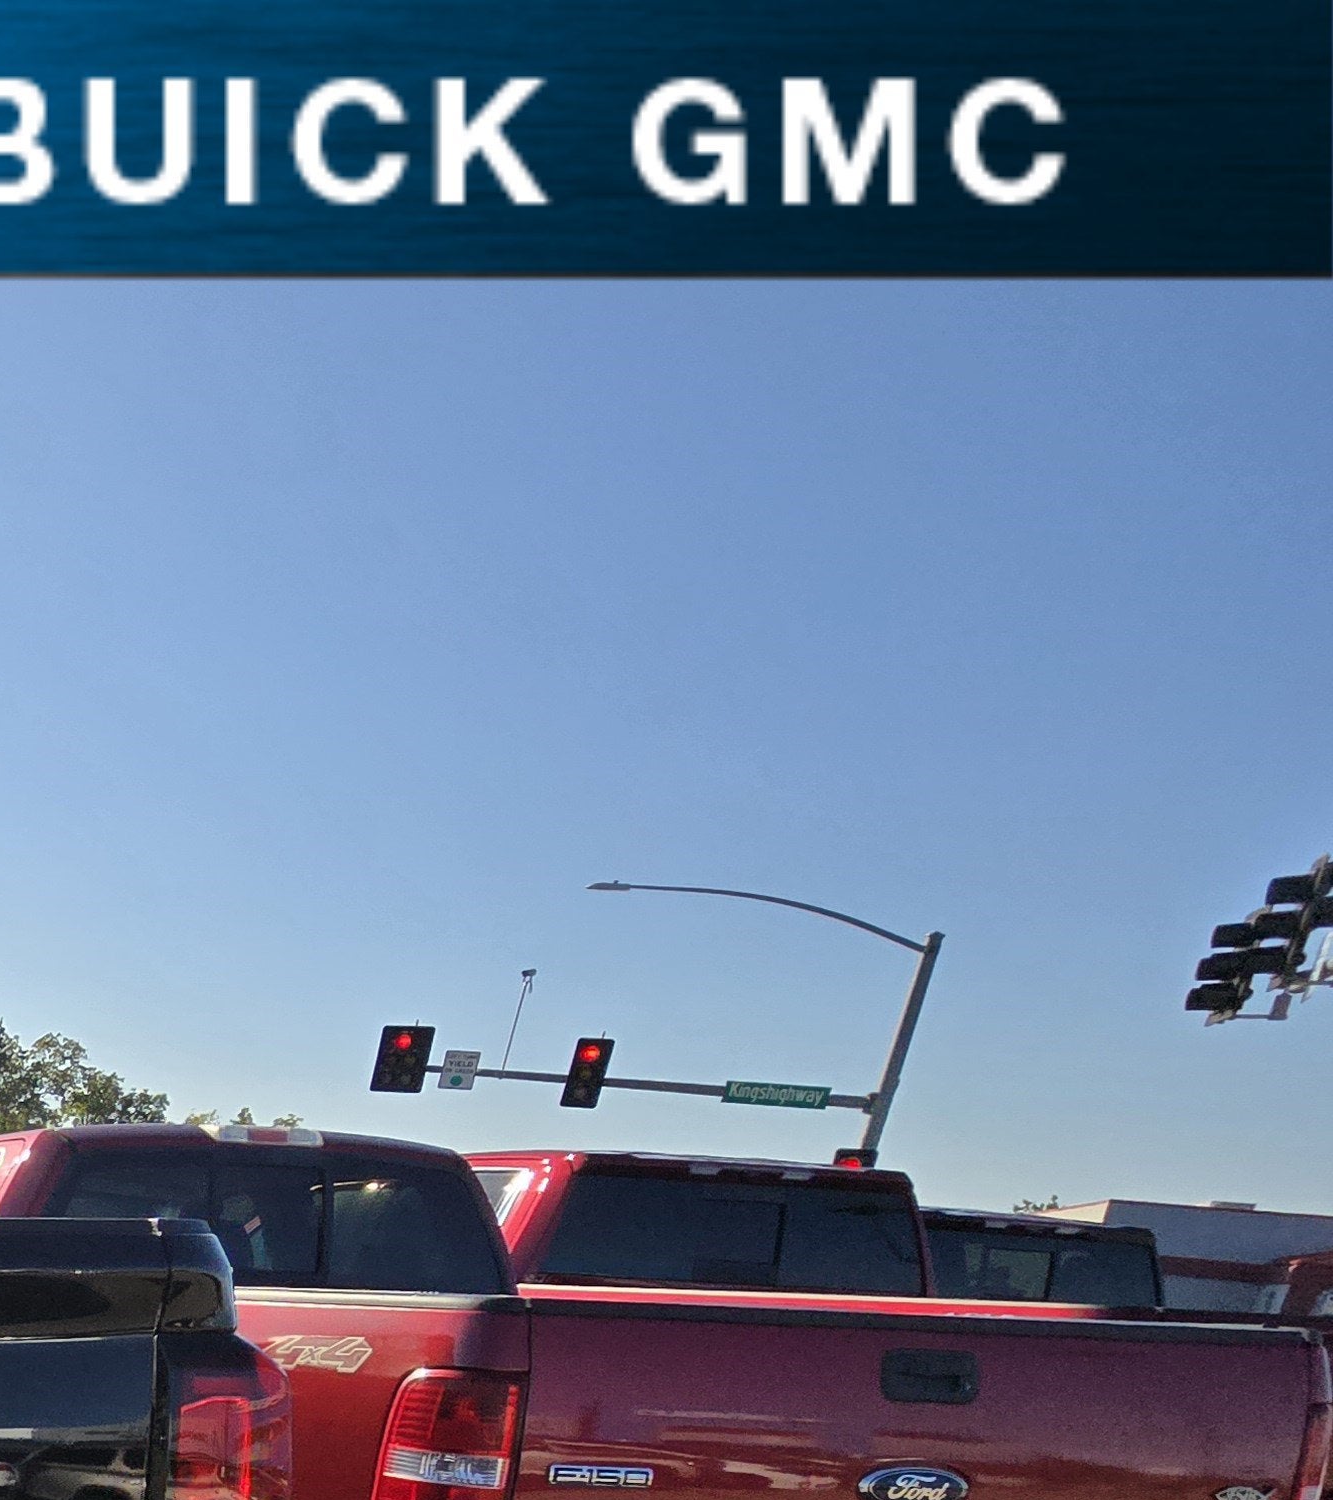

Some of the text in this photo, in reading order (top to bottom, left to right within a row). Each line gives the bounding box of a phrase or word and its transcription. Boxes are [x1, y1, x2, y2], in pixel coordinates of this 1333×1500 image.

[448, 1060, 474, 1068] YIELD
[728, 1082, 825, 1107] Kingshighway
[262, 1334, 373, 1374] 4x4
[886, 1474, 950, 1500] Ford
